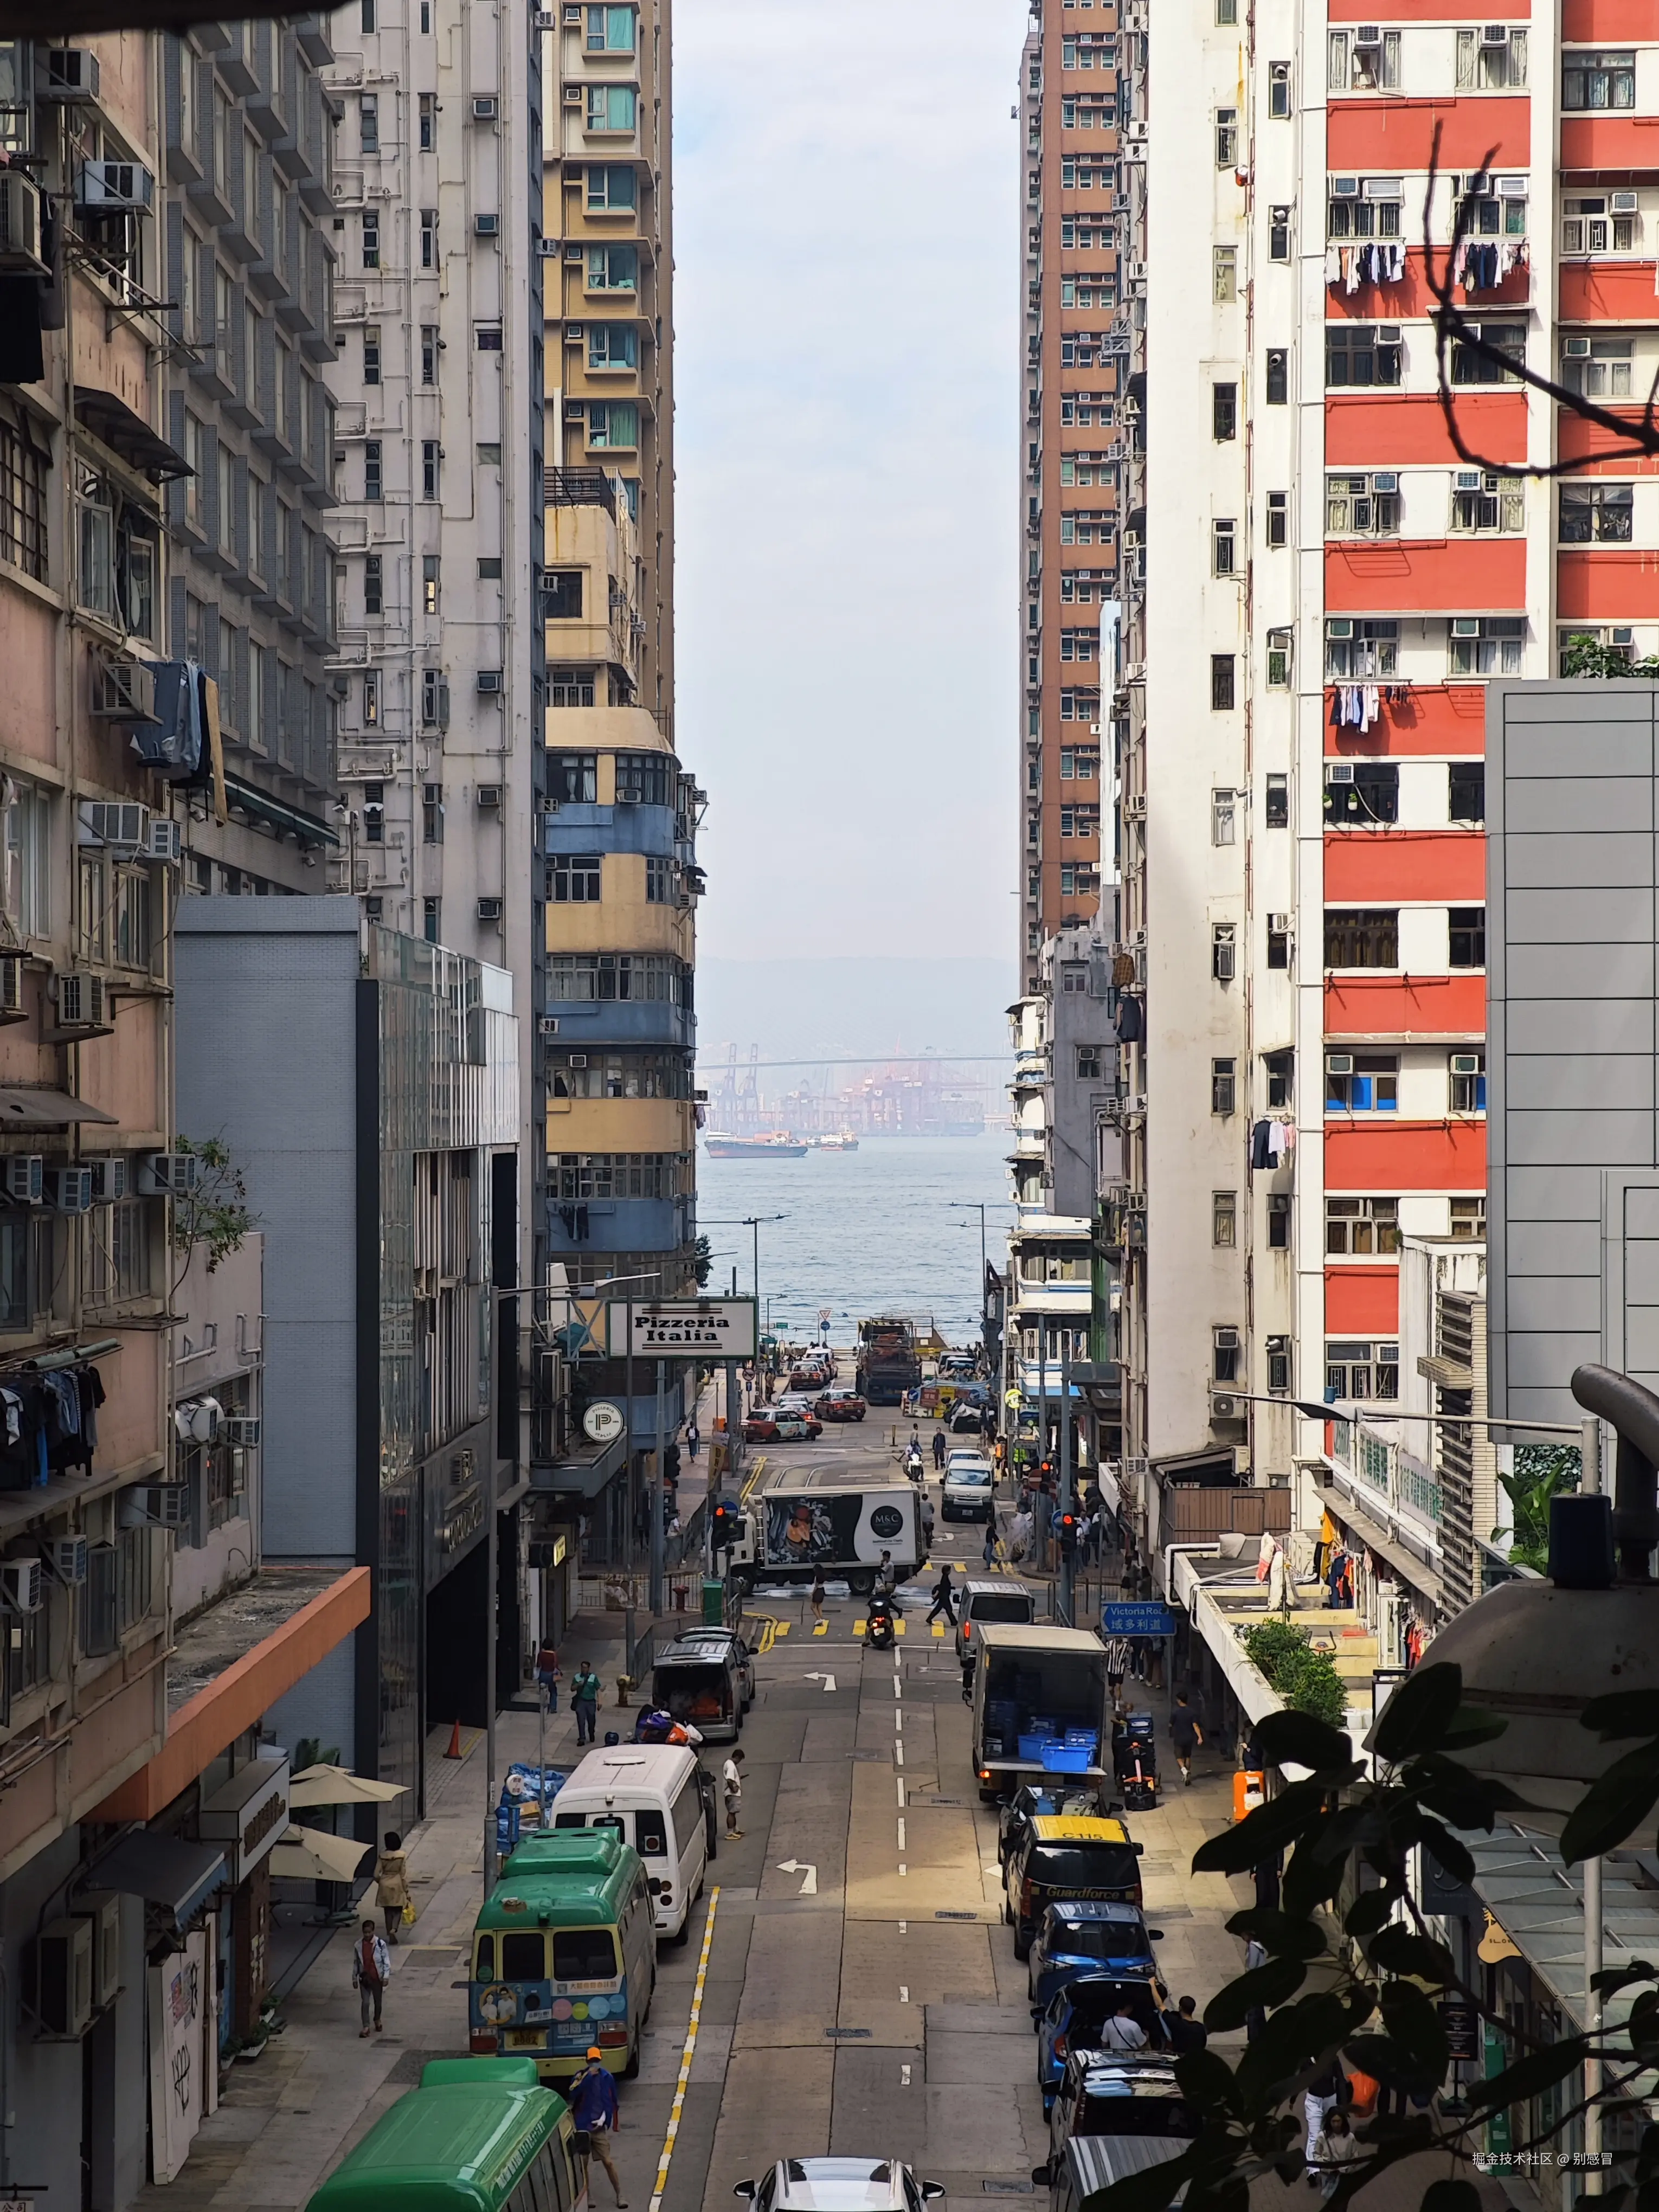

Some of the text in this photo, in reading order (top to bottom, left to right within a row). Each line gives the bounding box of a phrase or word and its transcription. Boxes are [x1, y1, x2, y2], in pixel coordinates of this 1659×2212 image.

[635, 1316, 730, 1328] Pizzeria
[647, 1330, 718, 1341] Italia
[875, 1514, 899, 1523] M&C
[1111, 1607, 1144, 1615] Victoria
[1111, 1618, 1161, 1631] 域多利道
[1046, 1886, 1120, 1900] Guardforce
